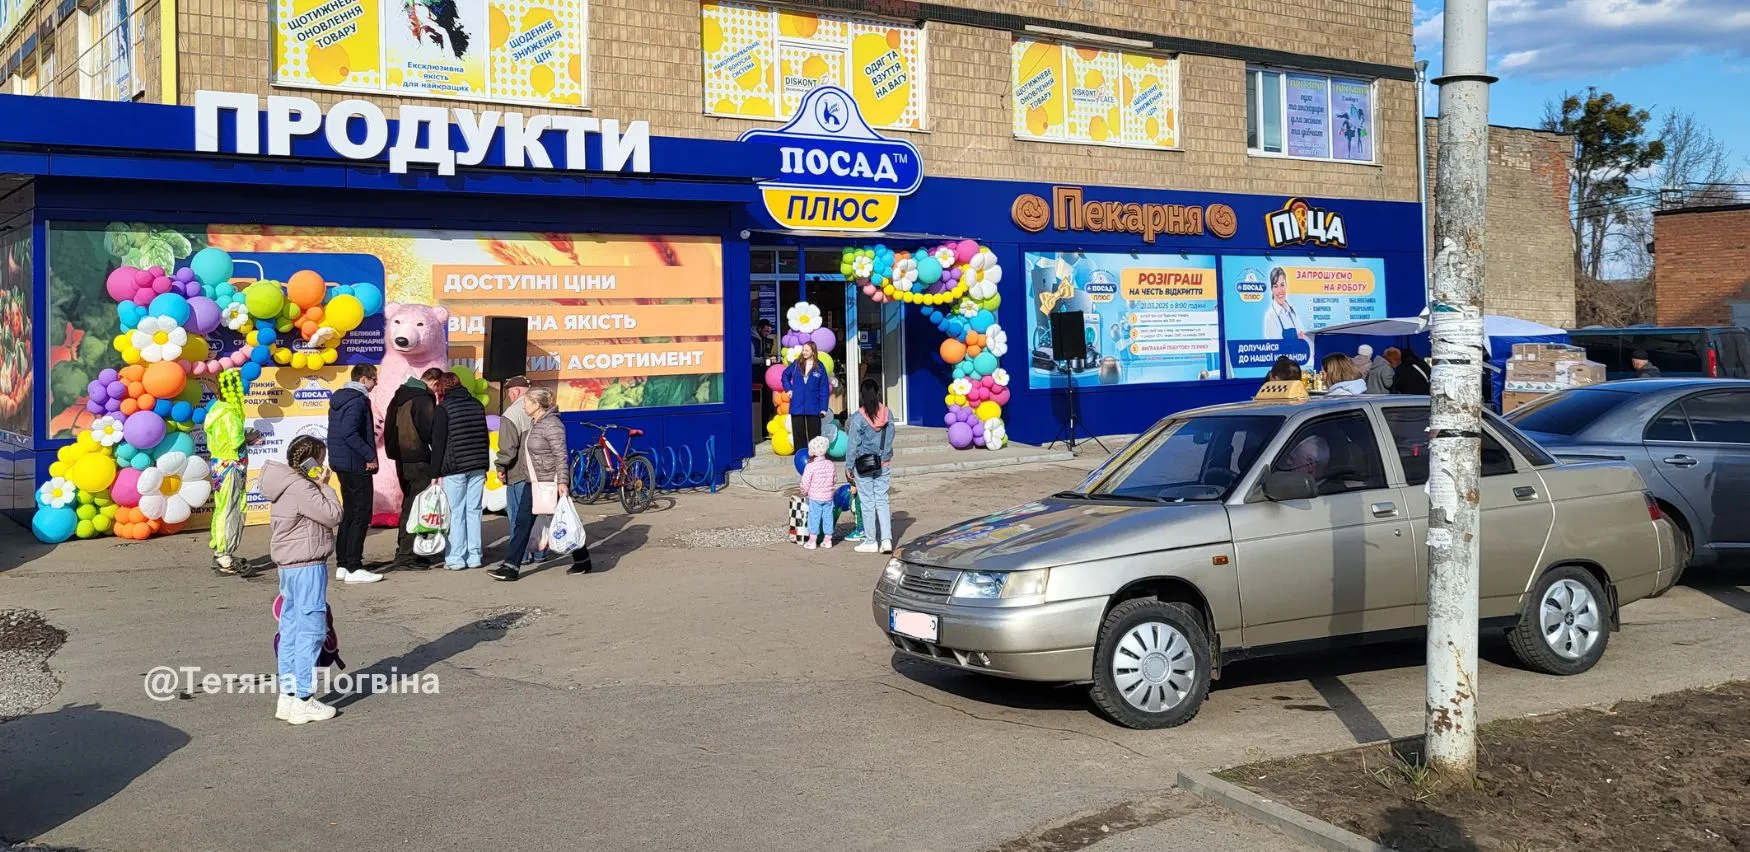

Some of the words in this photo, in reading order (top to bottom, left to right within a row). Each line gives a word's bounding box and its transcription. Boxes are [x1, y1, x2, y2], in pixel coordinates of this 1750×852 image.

[297, 6, 363, 41] ОНОВЛЕННЯ
[316, 23, 356, 48] ТОВАРУ
[508, 20, 554, 50] ЩОДЕННЕ
[512, 30, 562, 62] ЗНИЖЕННЯ
[407, 61, 464, 73] Ексклюзивна
[534, 50, 552, 64] ЦІН
[864, 58, 887, 76] ОДЯГ
[888, 50, 898, 61] ТА
[423, 72, 449, 81] якість
[786, 76, 816, 87] DISKONT
[871, 62, 902, 86] ВЗУТТЯ
[1016, 68, 1052, 97] ЩОТИЖНЕВЕ
[402, 80, 419, 89] для
[421, 81, 469, 92] найкращих
[874, 86, 888, 98] НА
[888, 73, 908, 93] ВАГУ
[1020, 78, 1054, 104] ОНОВЛЕННЯ
[1072, 88, 1096, 96] DISKONT
[1030, 91, 1052, 110] ТОВАРУ
[194, 90, 650, 176] ПРОДУКТИ
[780, 147, 898, 182] ПОСАД
[786, 196, 880, 222] ПЛЮС
[1052, 186, 1203, 243] Пекарня
[1268, 203, 1347, 247] ПІЦА
[444, 274, 558, 293] ДОСТУПНІ
[564, 275, 616, 292] ЦІНИ
[1138, 273, 1202, 286] РОЗІГРАШ
[1296, 271, 1352, 280] ЗАПРОШУЄМО
[1165, 288, 1202, 296] ВІДКРИТТЯ
[1338, 284, 1366, 292] РОБОТУ
[448, 316, 558, 334] ВІДНА
[564, 314, 636, 330] ЯКІСТЬ
[1238, 343, 1279, 353] ДОЛУЧАЙСЯ
[568, 350, 704, 370] АСОРТИМЕНТ
[1239, 355, 1249, 364] ДО
[1250, 353, 1273, 362] НАШОЇ
[302, 390, 328, 398] ПОСАД
